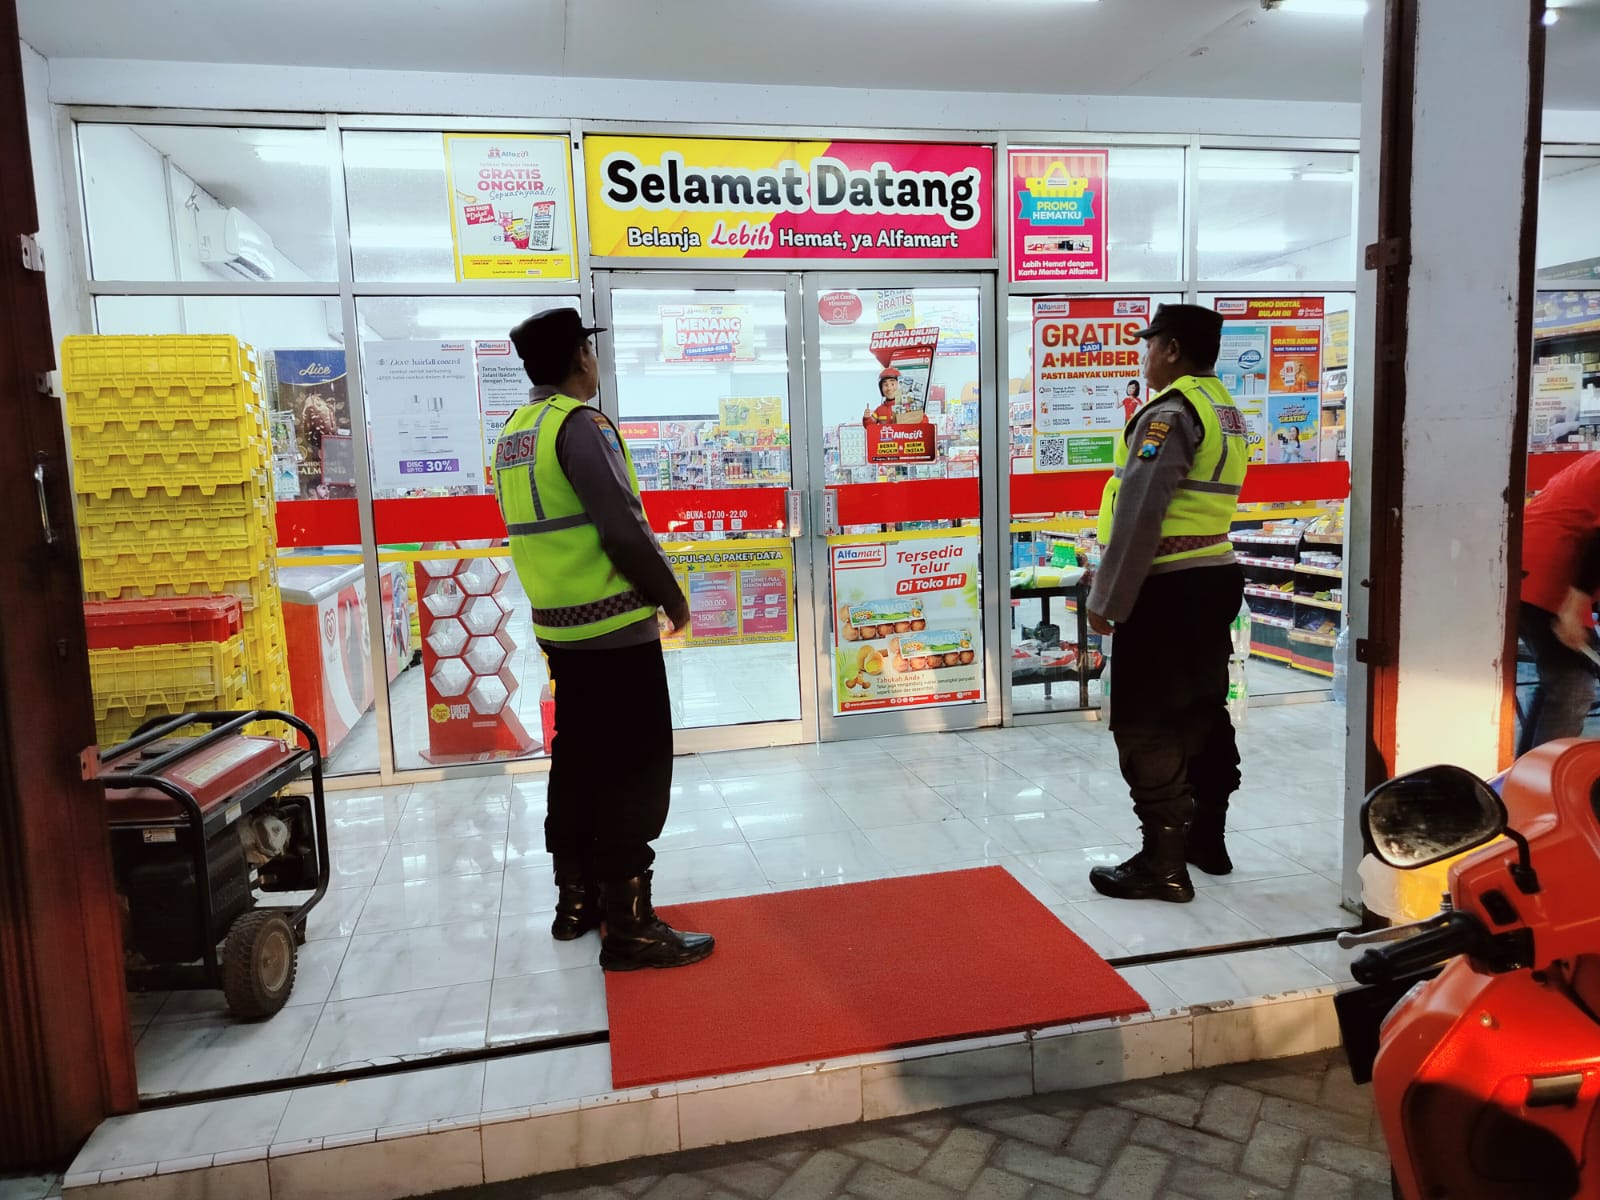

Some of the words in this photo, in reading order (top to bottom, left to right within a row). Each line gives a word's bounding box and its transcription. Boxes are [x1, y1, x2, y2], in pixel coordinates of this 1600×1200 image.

[478, 168, 541, 180] GRATIS
[477, 180, 545, 191] ONGKIR
[607, 159, 804, 206] Selamat
[815, 164, 974, 221] Datang
[1037, 201, 1078, 211] PROMO
[1032, 211, 1081, 220] HEMATKU
[627, 226, 701, 252] Belanja
[711, 222, 771, 248] Lebih
[779, 229, 847, 251] Hemat,
[851, 233, 873, 253] ya
[876, 229, 959, 248] Alfamart
[878, 295, 913, 311] GRATIS
[676, 317, 741, 331] MENANG
[676, 331, 740, 346] BANYAK
[1042, 322, 1141, 347] GRATIS
[871, 335, 937, 349] DIMANAPUN
[1082, 343, 1100, 352] JADI
[299, 363, 332, 376] Aice
[1067, 370, 1101, 379] BANYAK
[1102, 368, 1140, 378] UNTUNG!
[893, 430, 923, 440] Alfagift
[496, 434, 535, 462] POLISI
[426, 460, 453, 472] 30%
[707, 510, 725, 519] 07.00
[729, 509, 748, 519] 22.00
[679, 553, 712, 564] PULSA
[713, 553, 721, 563] &
[722, 552, 754, 562] PAKET
[756, 551, 783, 561] DATA
[837, 548, 881, 560] Alfamart
[896, 545, 964, 564] Tersedia
[911, 561, 950, 576] Telur
[900, 582, 913, 593] Di
[915, 578, 944, 590] Toko
[946, 575, 962, 586] Ini
